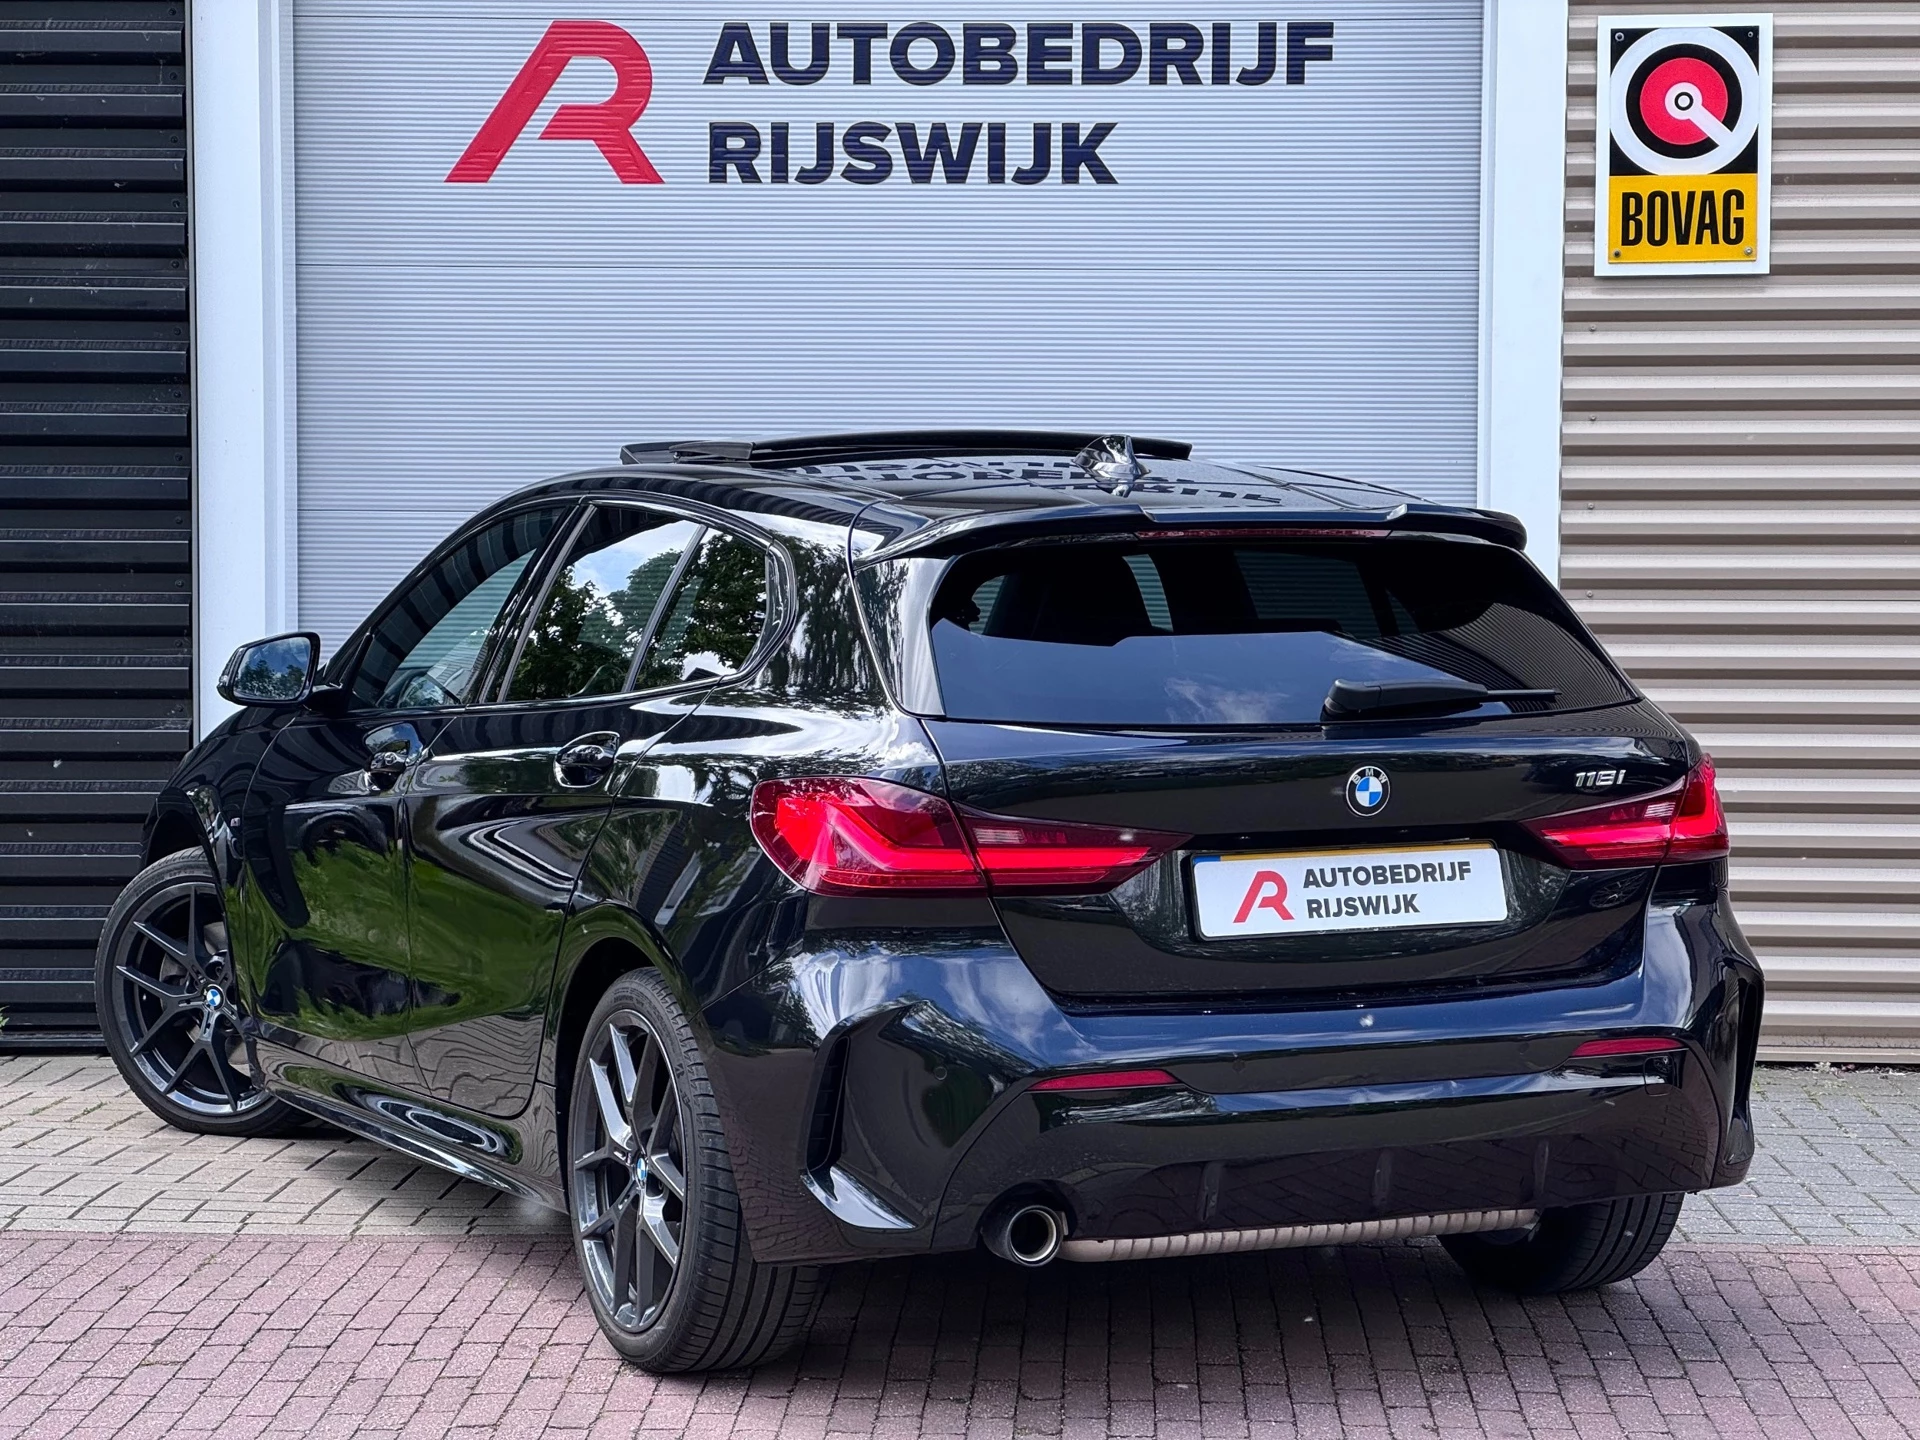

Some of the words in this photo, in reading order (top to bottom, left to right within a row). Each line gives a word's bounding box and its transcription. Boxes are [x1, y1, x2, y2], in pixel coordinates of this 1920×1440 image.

[703, 21, 1333, 86] AUTOBEDRIJF
[708, 122, 1118, 185] RIJSWIJK
[1621, 189, 1745, 246] BOVAG
[1303, 861, 1472, 889] AUTOBEDRIJF
[1306, 892, 1421, 919] RIJSWIJK
